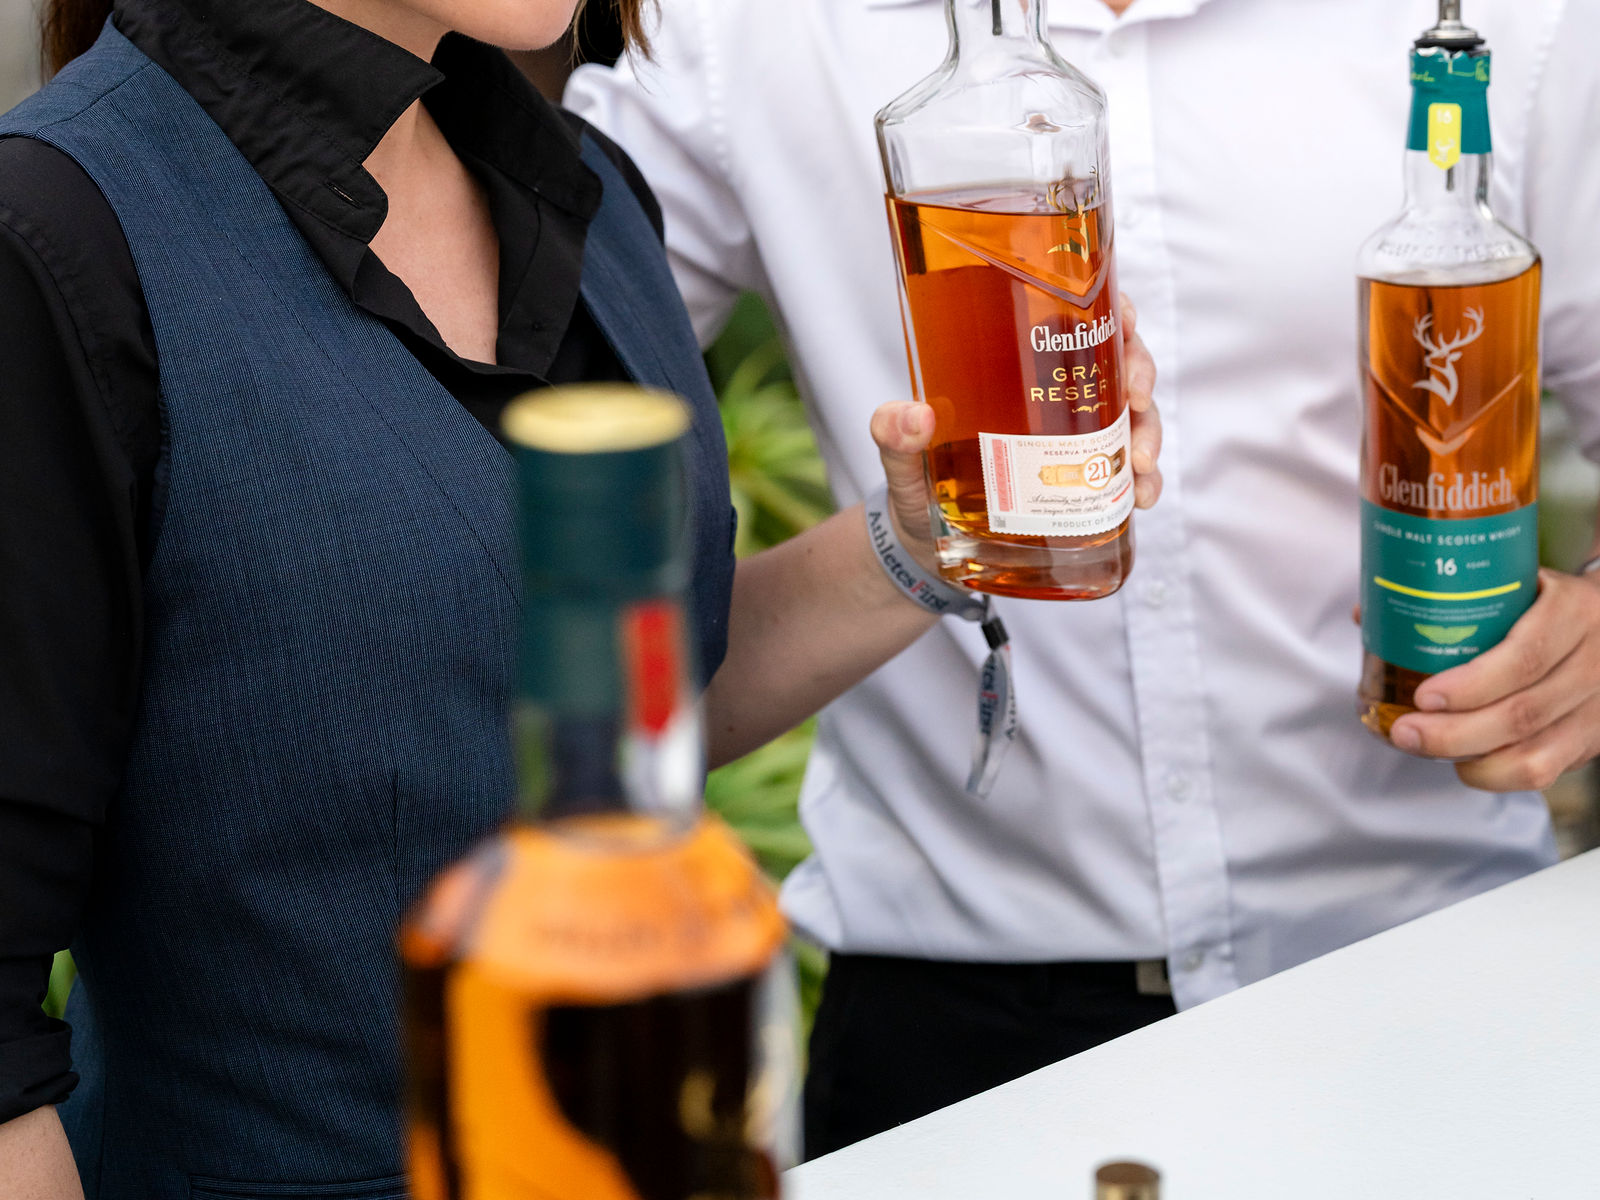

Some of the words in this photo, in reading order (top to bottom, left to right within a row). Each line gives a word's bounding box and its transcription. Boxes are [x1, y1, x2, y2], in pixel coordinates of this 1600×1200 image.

[1030, 309, 1117, 352] Glenfiddich
[1052, 361, 1106, 382] GRA
[1030, 379, 1107, 402] RESER
[1017, 440, 1053, 448] SINGLE
[1059, 438, 1086, 447] MALT
[1087, 461, 1108, 482] 21
[1379, 462, 1513, 511] Glenfiddich
[1052, 520, 1092, 529] PRODUCT
[1095, 518, 1105, 526] OF
[1405, 531, 1433, 544] MALT
[1437, 534, 1486, 546] SCOTCH
[1435, 557, 1458, 576] 16
